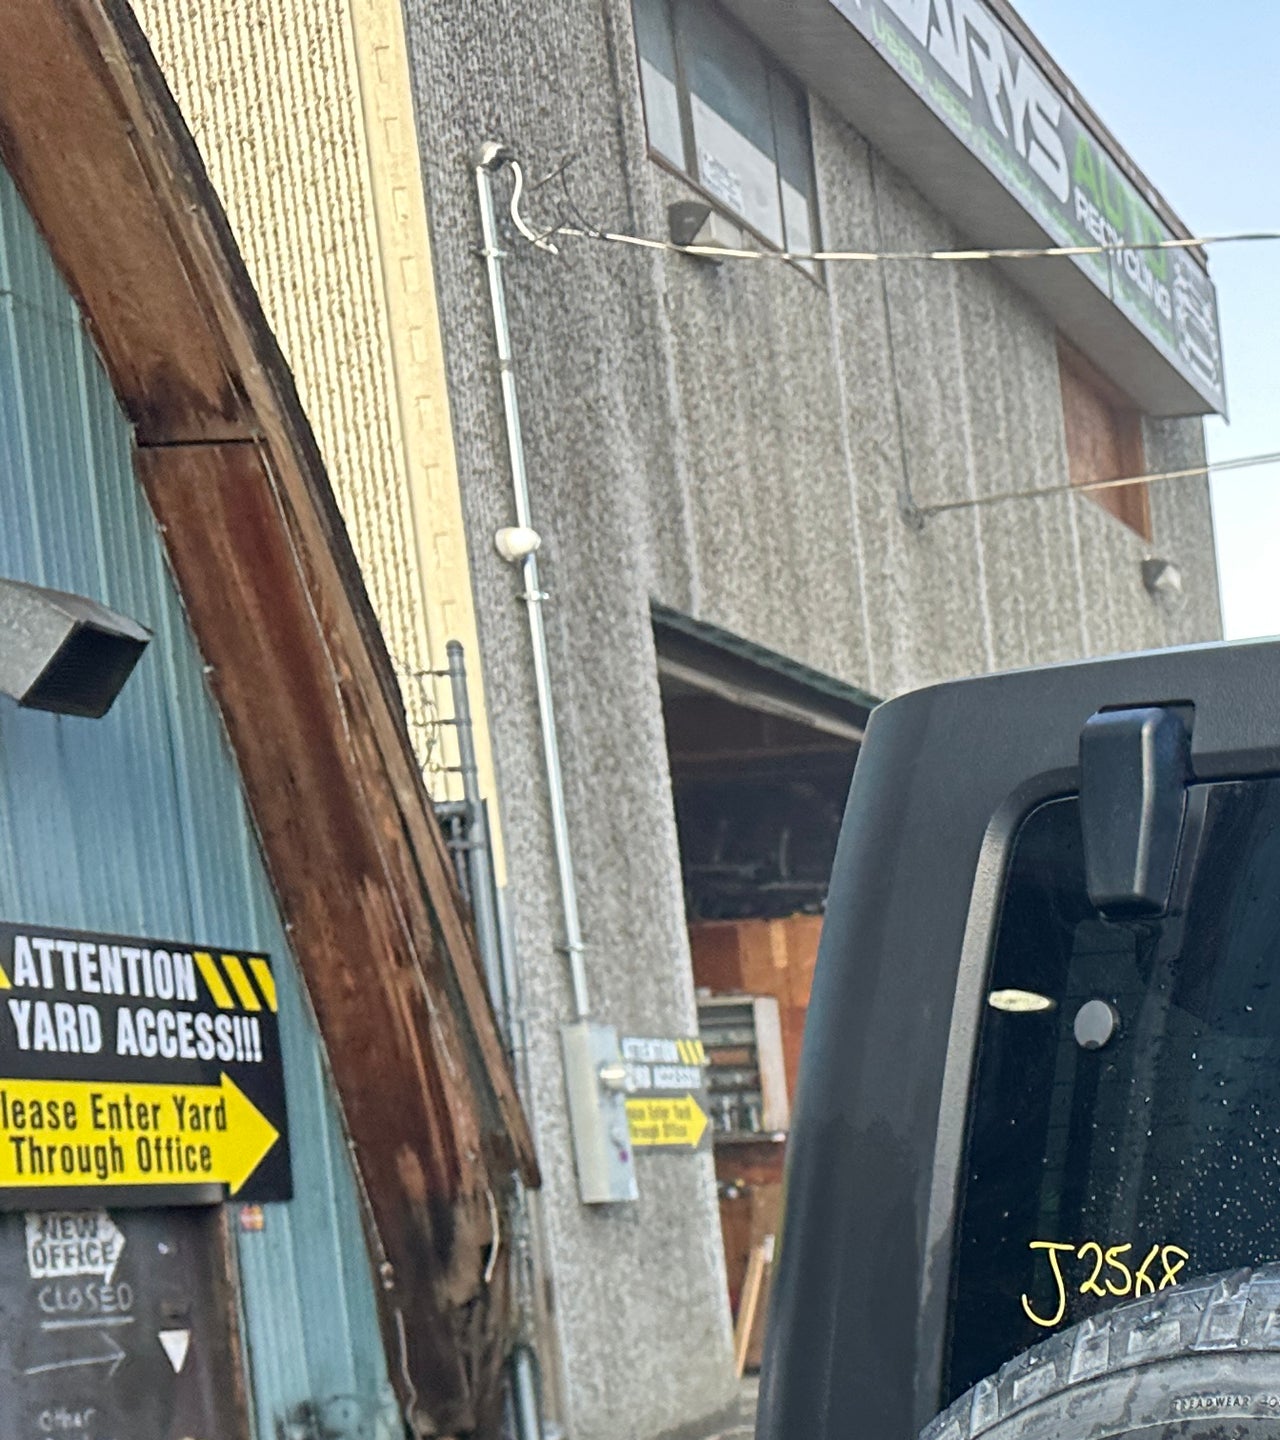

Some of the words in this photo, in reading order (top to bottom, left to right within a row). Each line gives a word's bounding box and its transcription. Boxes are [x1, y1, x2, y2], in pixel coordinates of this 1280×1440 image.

[870, 5, 925, 86] USED
[884, 0, 1070, 204] ARYS
[1073, 132, 1168, 280] AUTO
[1074, 185, 1172, 320] RECYCLING
[14, 935, 198, 1002] ATTENTION
[8, 999, 103, 1054] YARD
[116, 1007, 263, 1063] ACCESS!!!
[0, 1090, 77, 1130] lease
[90, 1093, 160, 1132] Enter
[173, 1095, 227, 1132] Yard
[9, 1137, 124, 1180] Through
[136, 1137, 213, 1172] Office
[32, 1241, 115, 1269] OFFICE
[43, 1216, 99, 1239] NEW
[38, 1282, 134, 1313] CLOSED
[1020, 1240, 1190, 1327] J2568
